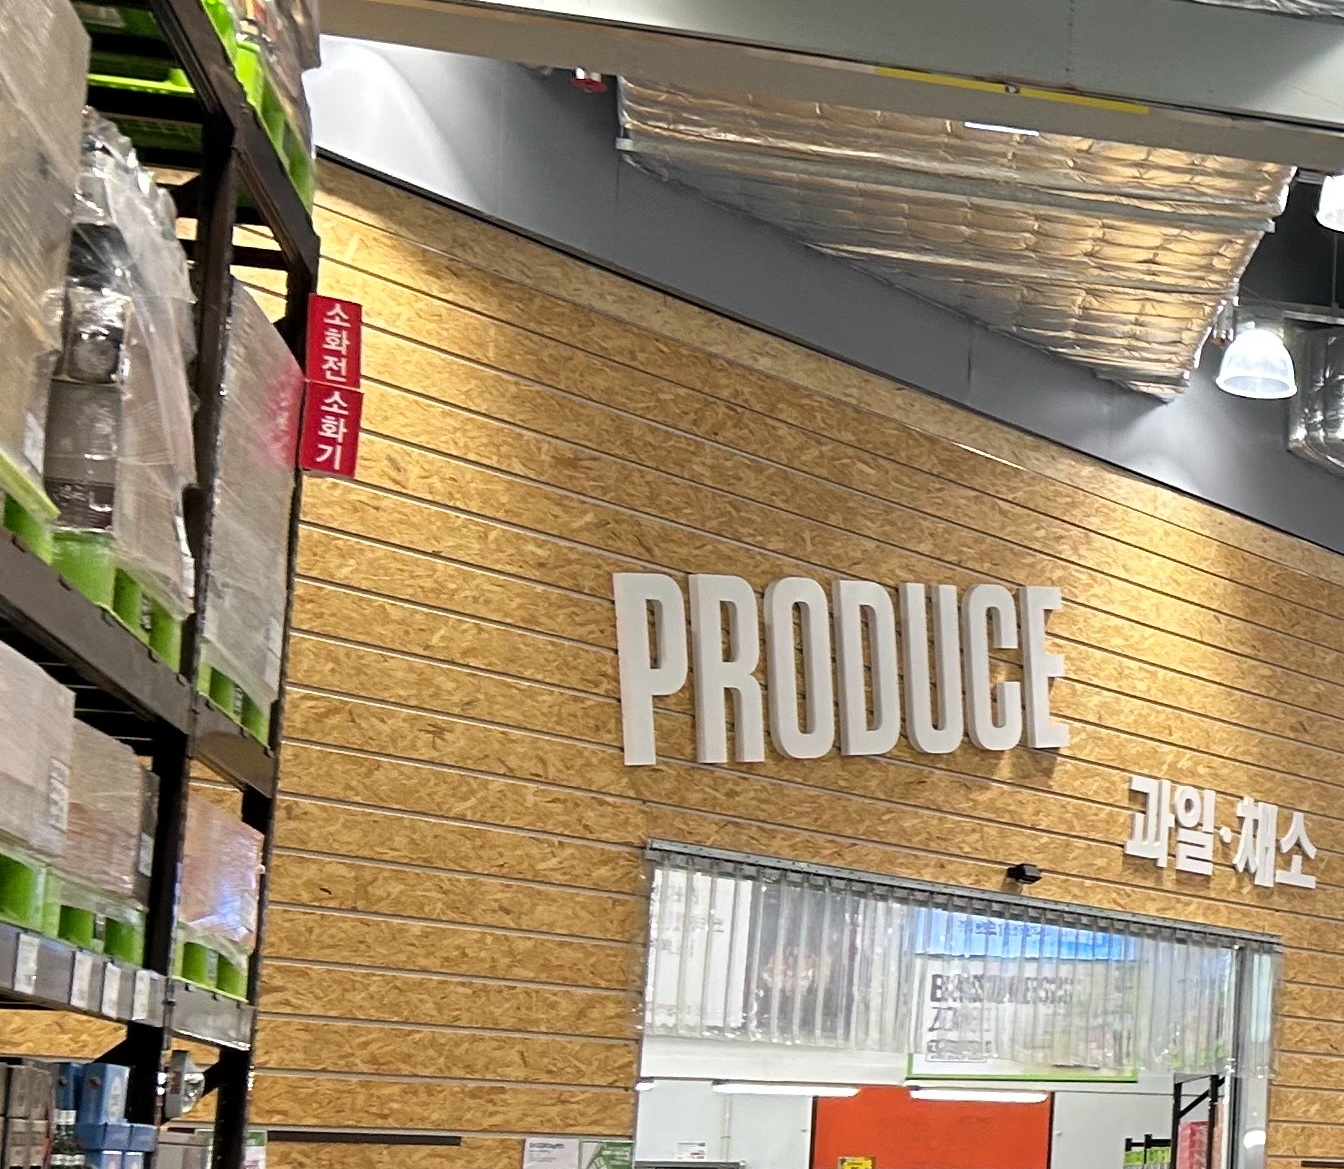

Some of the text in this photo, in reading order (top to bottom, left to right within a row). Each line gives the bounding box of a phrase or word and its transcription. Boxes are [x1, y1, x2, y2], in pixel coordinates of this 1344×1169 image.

[323, 303, 351, 383] 소화전
[316, 391, 350, 471] 소화기
[613, 572, 1070, 767] PRODUCE
